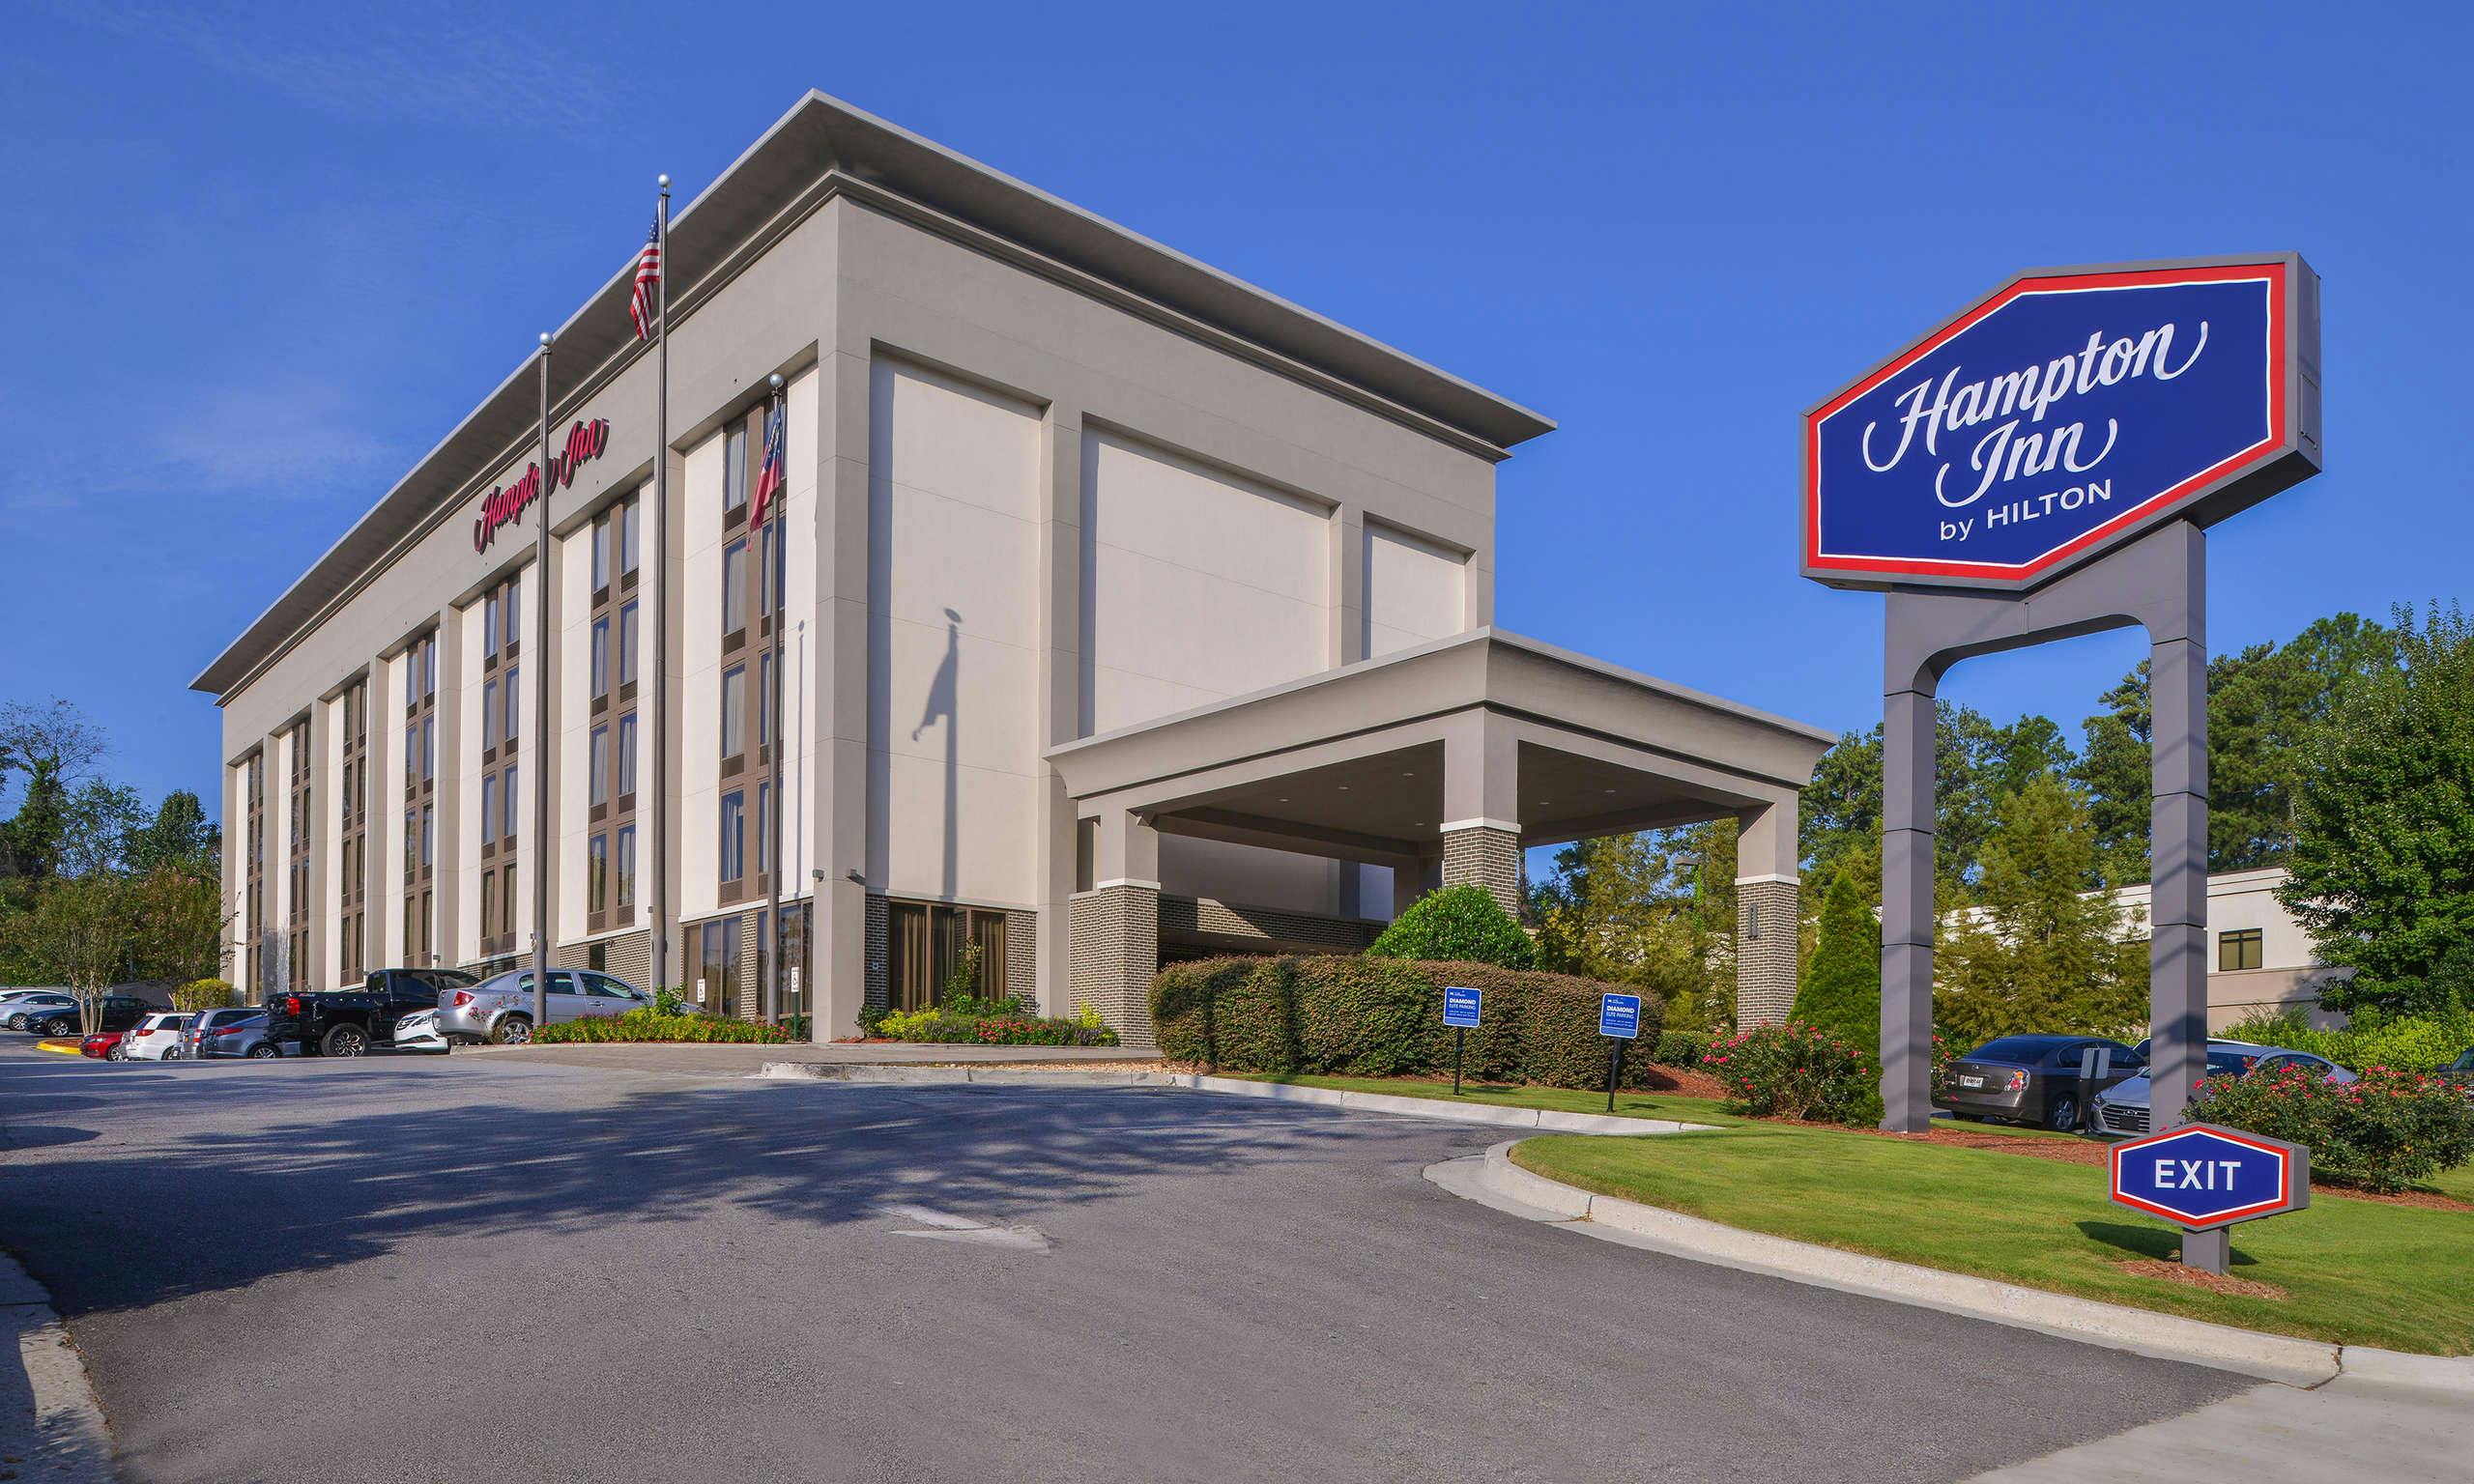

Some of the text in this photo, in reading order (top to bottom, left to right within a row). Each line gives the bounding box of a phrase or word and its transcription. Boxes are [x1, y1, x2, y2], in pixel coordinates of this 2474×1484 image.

[1862, 321, 2208, 471] Hampton
[559, 418, 610, 490] Inn
[1936, 417, 2118, 507] Inn
[1940, 478, 2112, 542] by HILTON
[2155, 1159, 2241, 1191] EXIT
